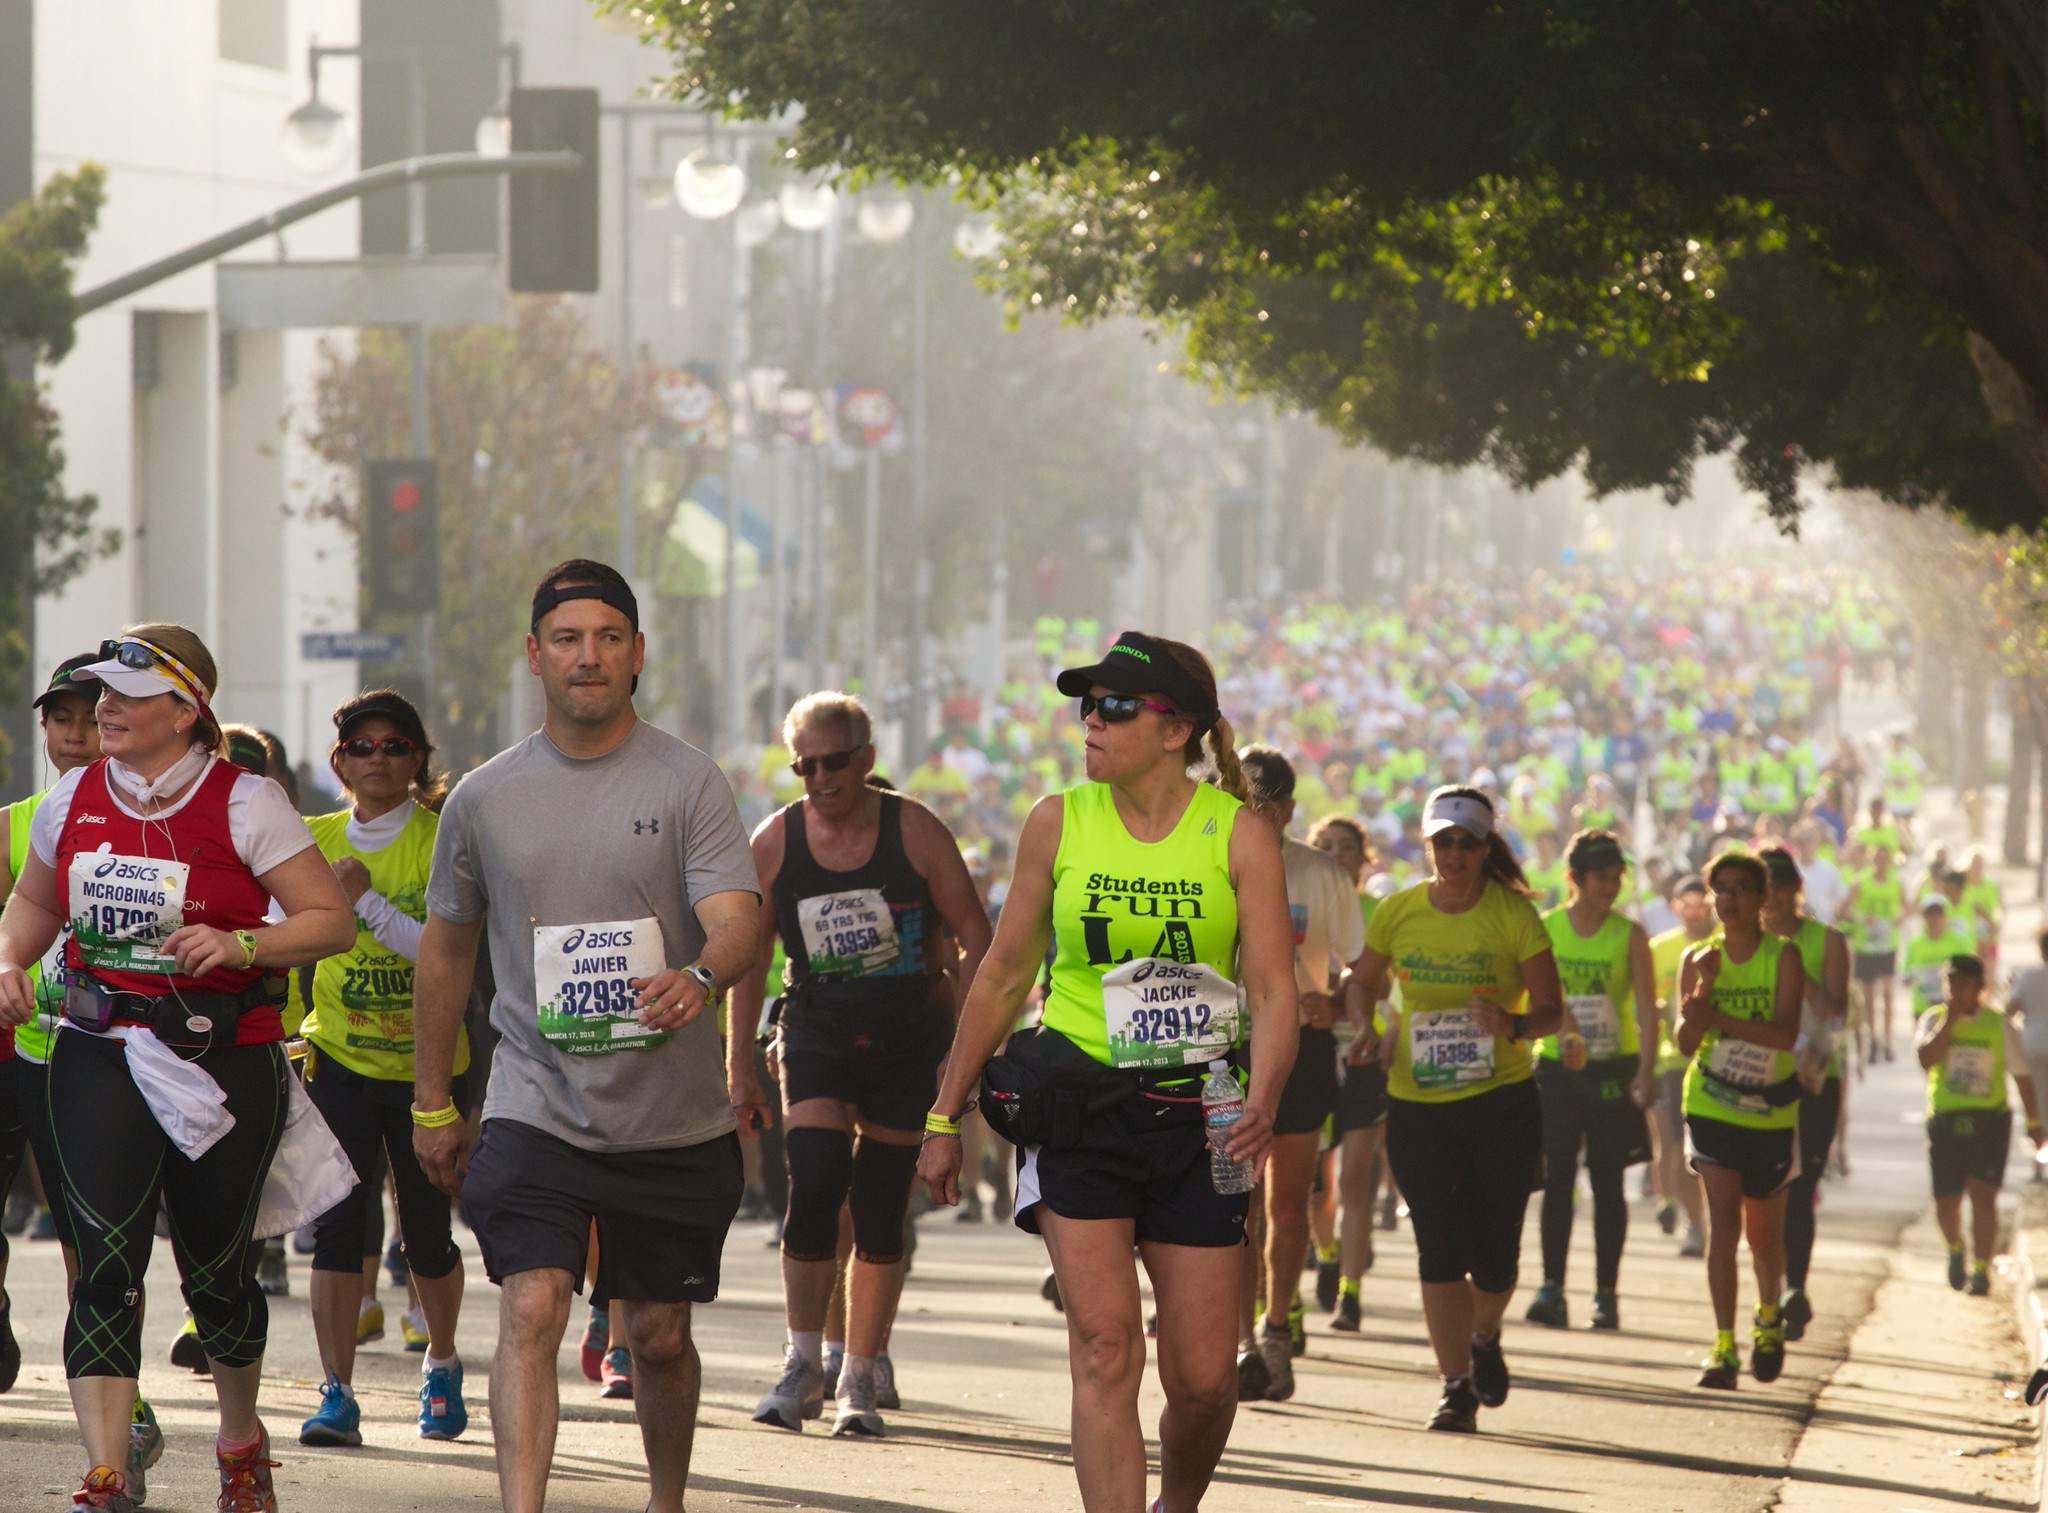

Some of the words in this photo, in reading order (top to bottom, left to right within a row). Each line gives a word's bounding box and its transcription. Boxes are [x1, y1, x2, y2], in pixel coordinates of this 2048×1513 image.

[1110, 644, 1151, 664] HONDA
[115, 863, 159, 881] asics
[83, 882, 165, 906] MCROBIN45
[1086, 873, 1203, 896] Students
[1080, 892, 1206, 919] run
[586, 931, 632, 948] asics
[1080, 915, 1197, 965] LA
[572, 956, 628, 975] JAVIER
[1155, 966, 1203, 980] asics
[1141, 985, 1196, 1004] JACKIE
[1132, 1004, 1212, 1042] 32912
[610, 1040, 646, 1049] MARATHON
[1118, 1060, 1140, 1069] MARCH
[1153, 1057, 1169, 1065] 2013
